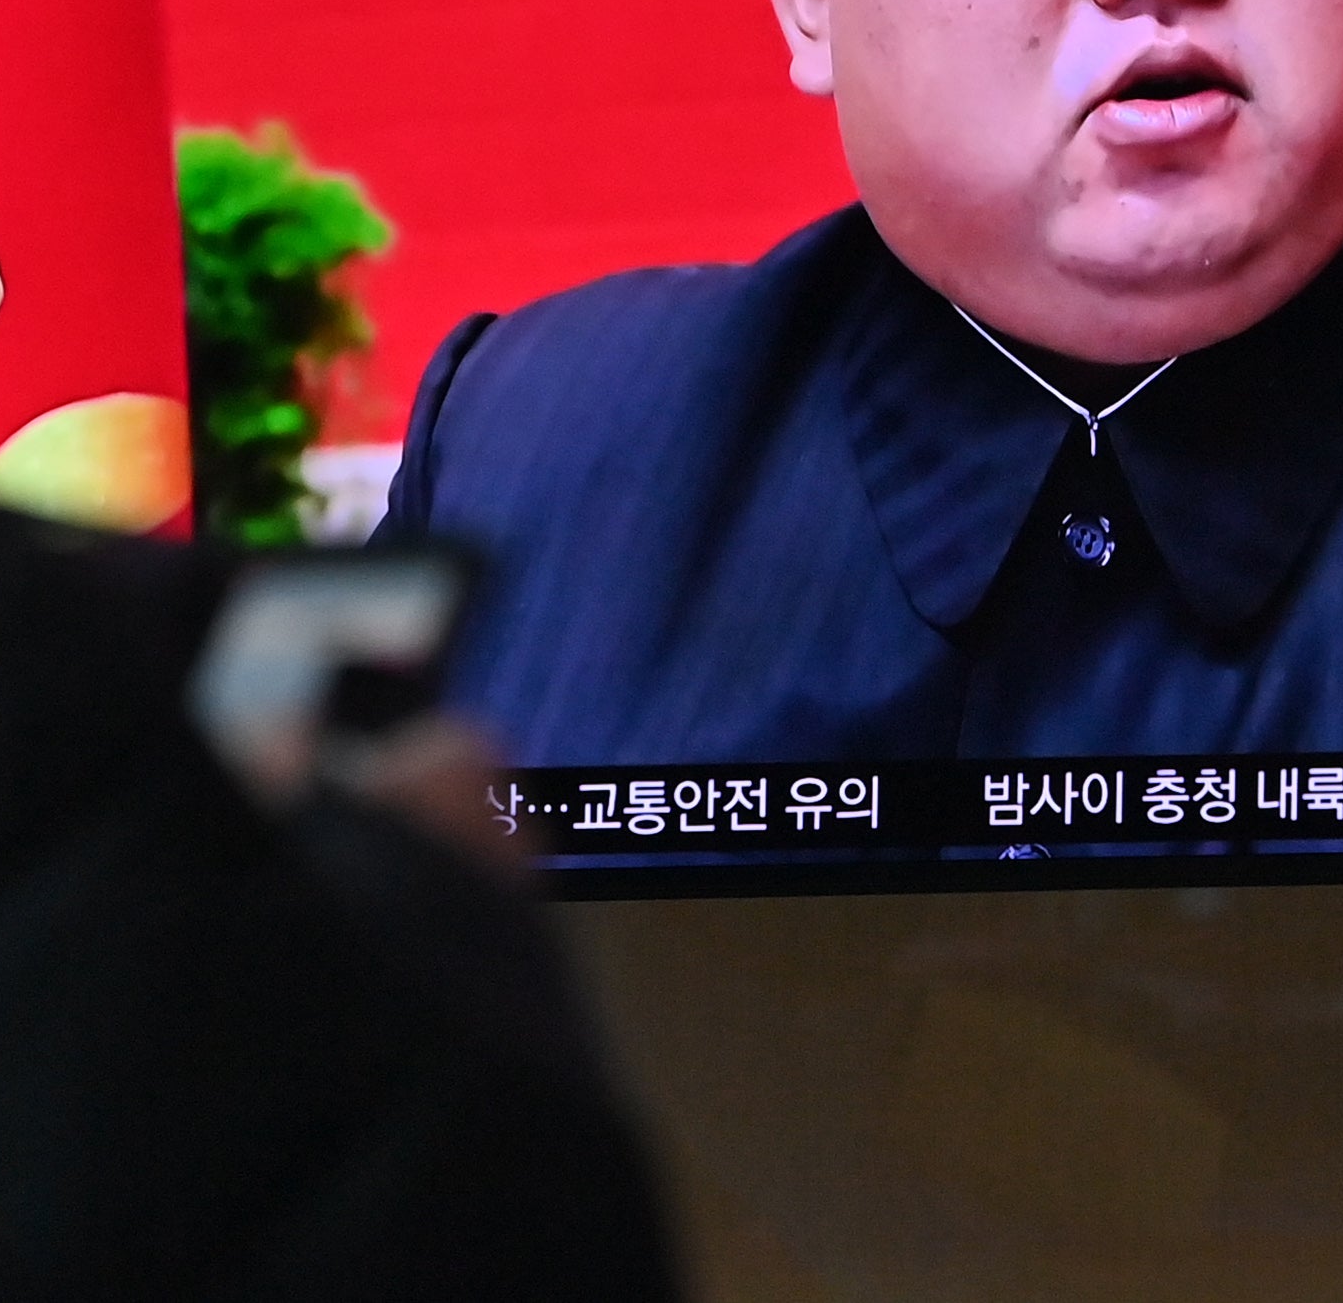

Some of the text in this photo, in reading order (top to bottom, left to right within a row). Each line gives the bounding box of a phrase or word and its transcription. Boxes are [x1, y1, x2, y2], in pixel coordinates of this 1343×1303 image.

[784, 775, 880, 831] 유의
[984, 770, 1124, 826] 밤사이
[1141, 768, 1236, 825] 충청
